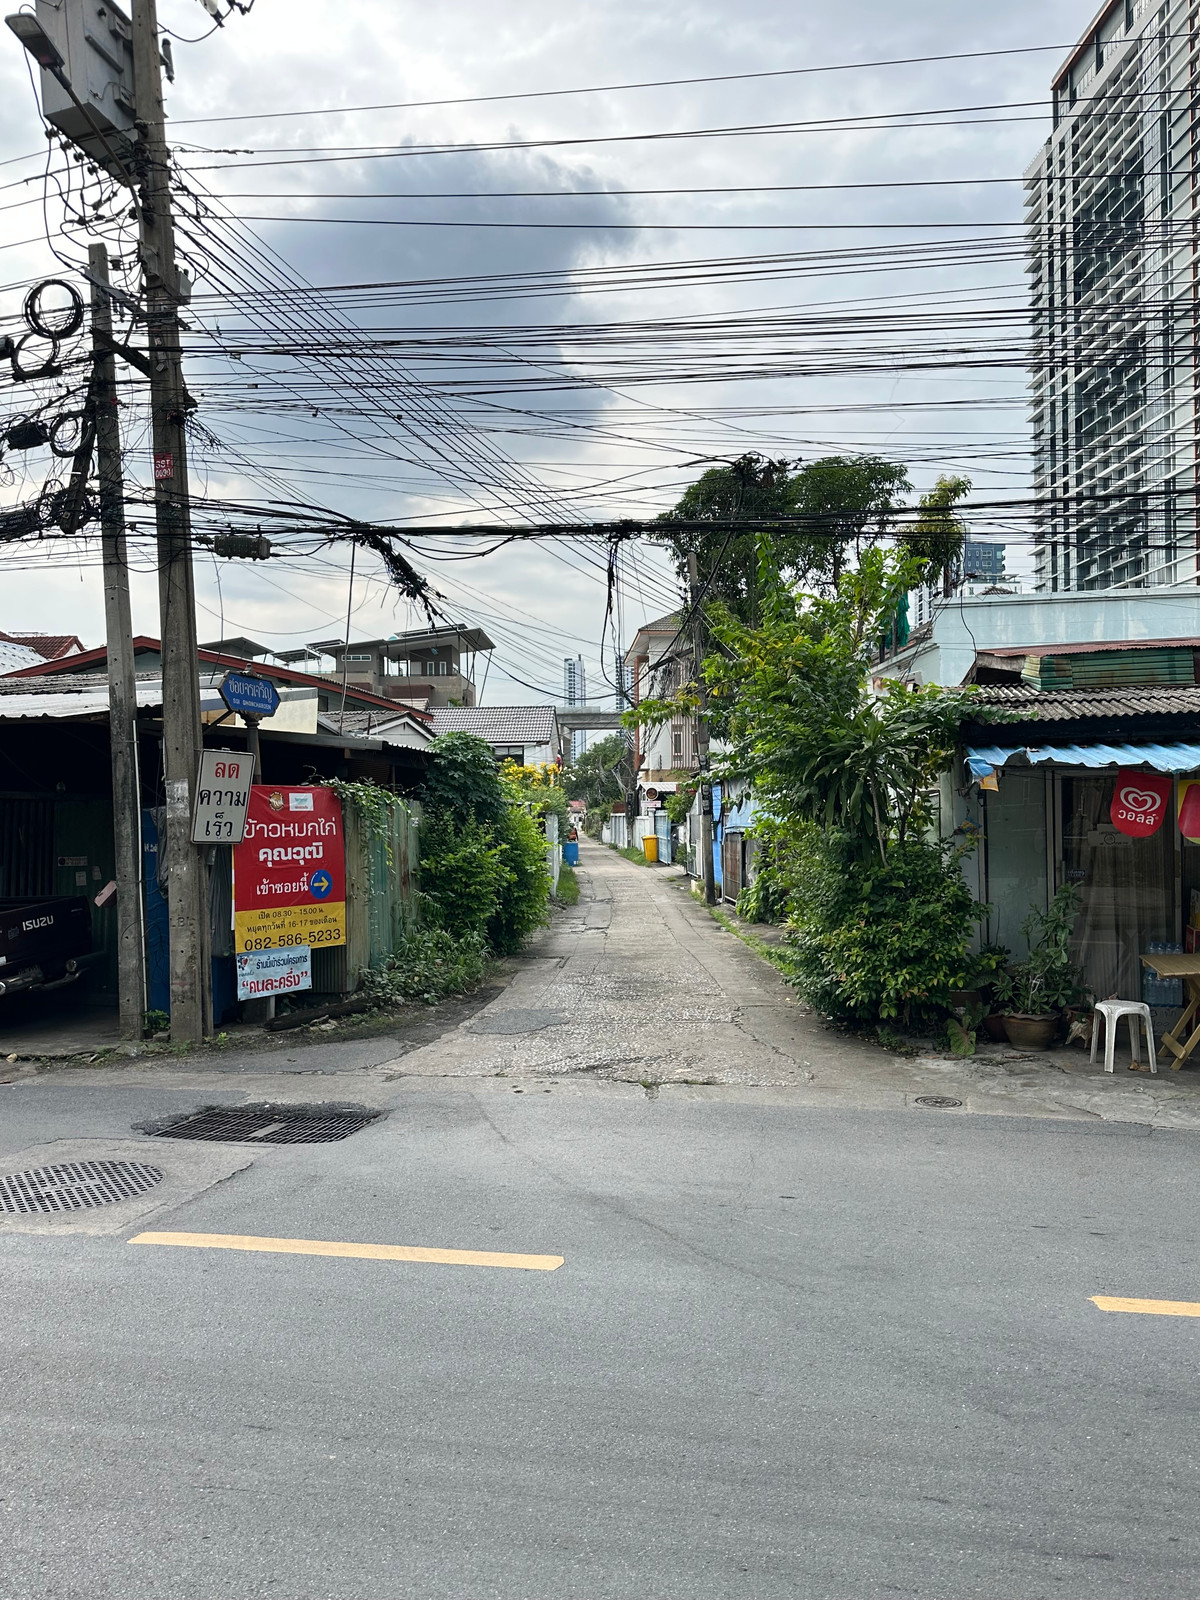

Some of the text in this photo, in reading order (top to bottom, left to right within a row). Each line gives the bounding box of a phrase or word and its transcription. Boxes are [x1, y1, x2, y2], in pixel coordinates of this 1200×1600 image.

[155, 459, 171, 469] SST
[215, 762, 240, 779] ลด
[200, 789, 247, 807] ความ
[205, 812, 233, 837] เร็ว
[1118, 810, 1157, 825] วอลล์
[244, 817, 336, 838] ข้าวหมกไก่
[259, 842, 323, 867] คุณวุฒิ
[256, 872, 309, 895] เข้าซอยนี้
[22, 915, 54, 931] ISUZU
[247, 915, 337, 934] หยุดทุกวันที่ 16-17 ของเดือน
[258, 911, 270, 920] เปิด
[244, 928, 341, 951] 082-586-5233
